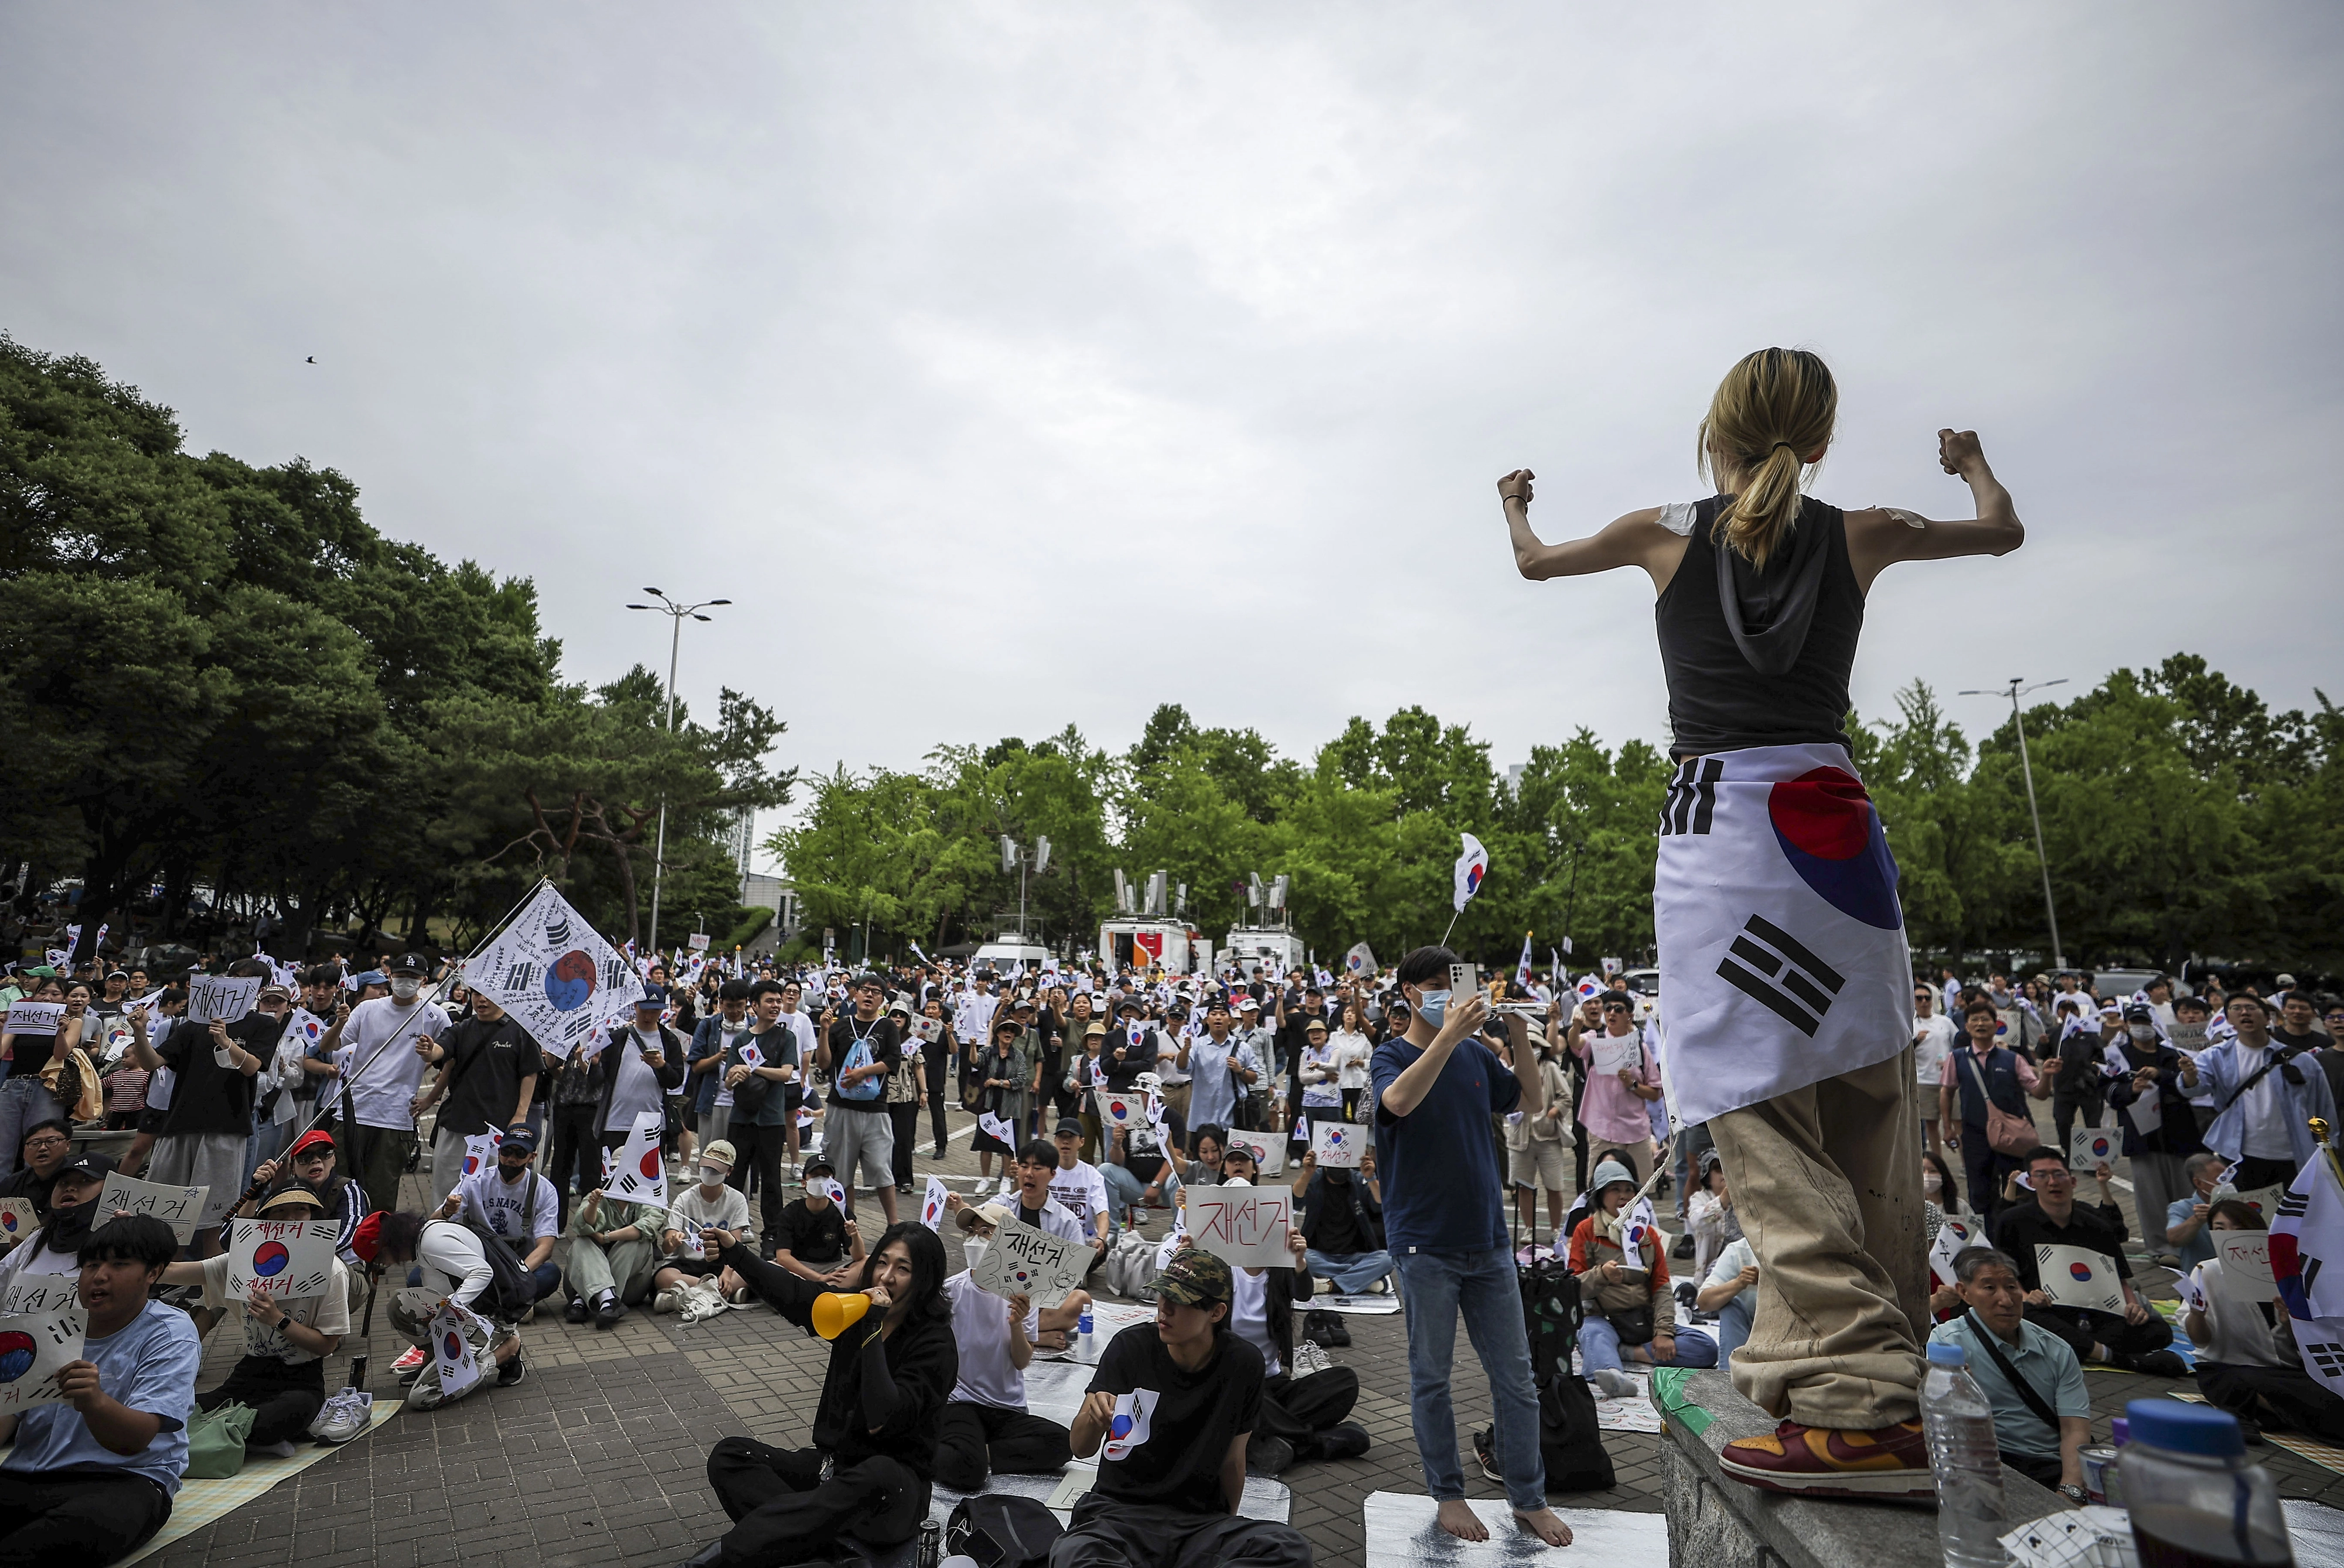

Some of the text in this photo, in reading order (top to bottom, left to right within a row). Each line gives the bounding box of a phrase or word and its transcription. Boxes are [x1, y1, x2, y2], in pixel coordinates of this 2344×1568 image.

[406, 955, 415, 966] LA
[190, 984, 249, 1021] 재선거
[12, 1008, 59, 1024] 재선거
[1594, 1042, 1624, 1054] 재선거
[1321, 1150, 1352, 1164] 재선거
[107, 1189, 187, 1219] 재선거
[255, 1222, 304, 1240] 재선거
[1197, 1197, 1289, 1253] 재선거
[1004, 1233, 1065, 1269] 재선거
[2228, 1243, 2271, 1265] 재선
[246, 1274, 294, 1297] 재선거
[6, 1286, 77, 1313] 재선거
